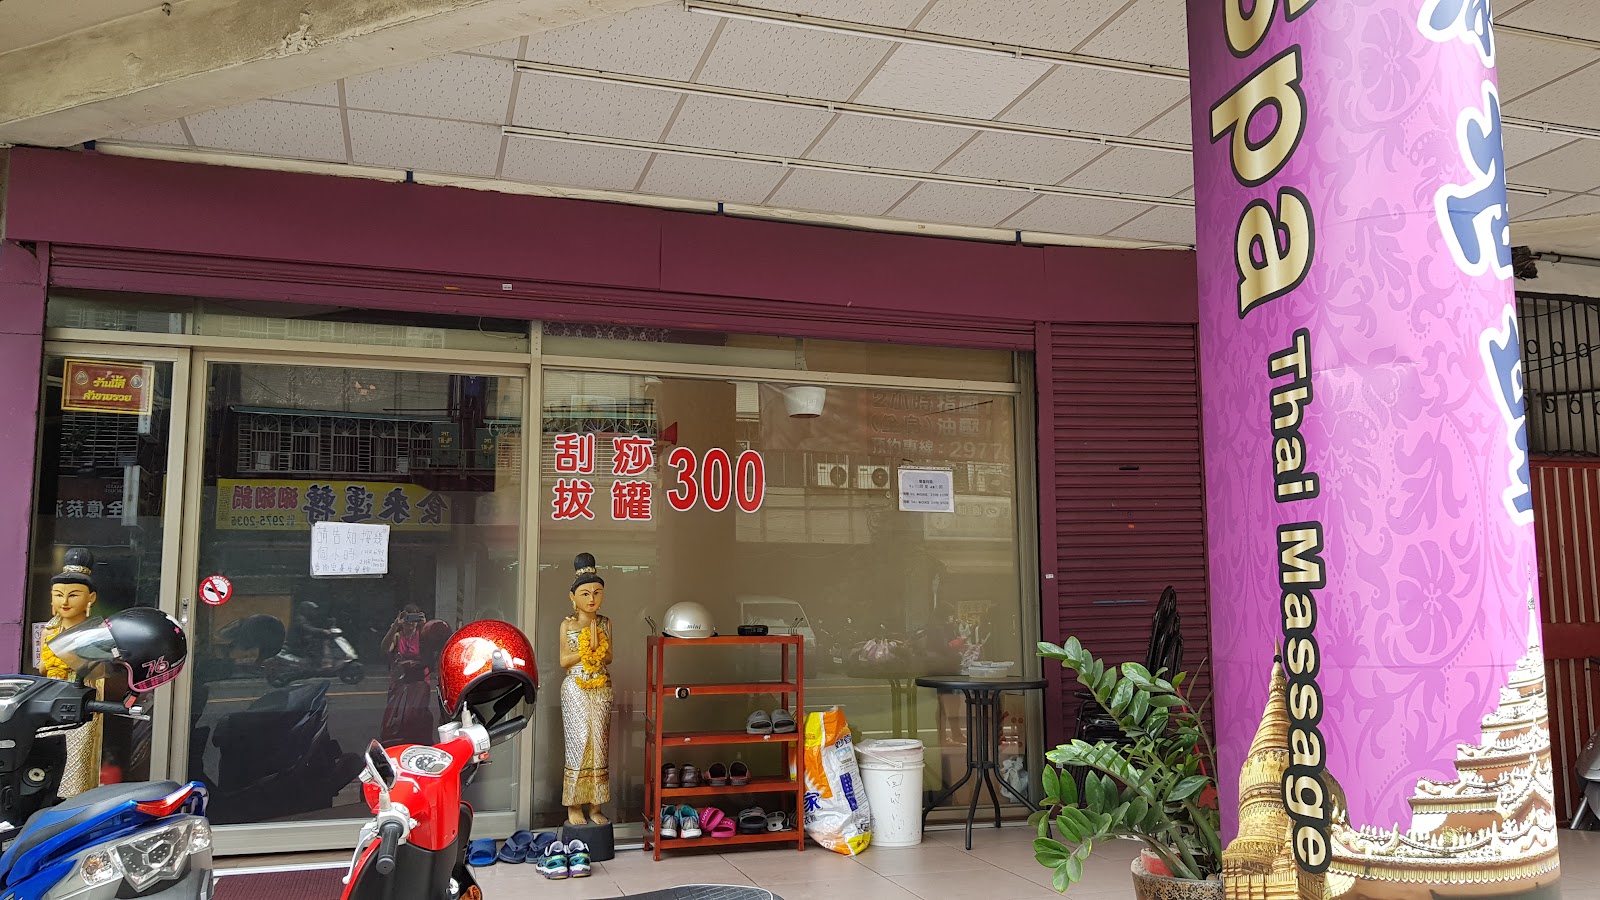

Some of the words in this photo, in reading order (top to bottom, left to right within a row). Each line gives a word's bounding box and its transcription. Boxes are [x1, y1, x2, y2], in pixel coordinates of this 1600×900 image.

[1268, 327, 1320, 503] Thai
[551, 478, 653, 521] 拔罐
[666, 446, 766, 514] 300
[141, 654, 170, 679] 76
[1277, 520, 1332, 874] Massage
